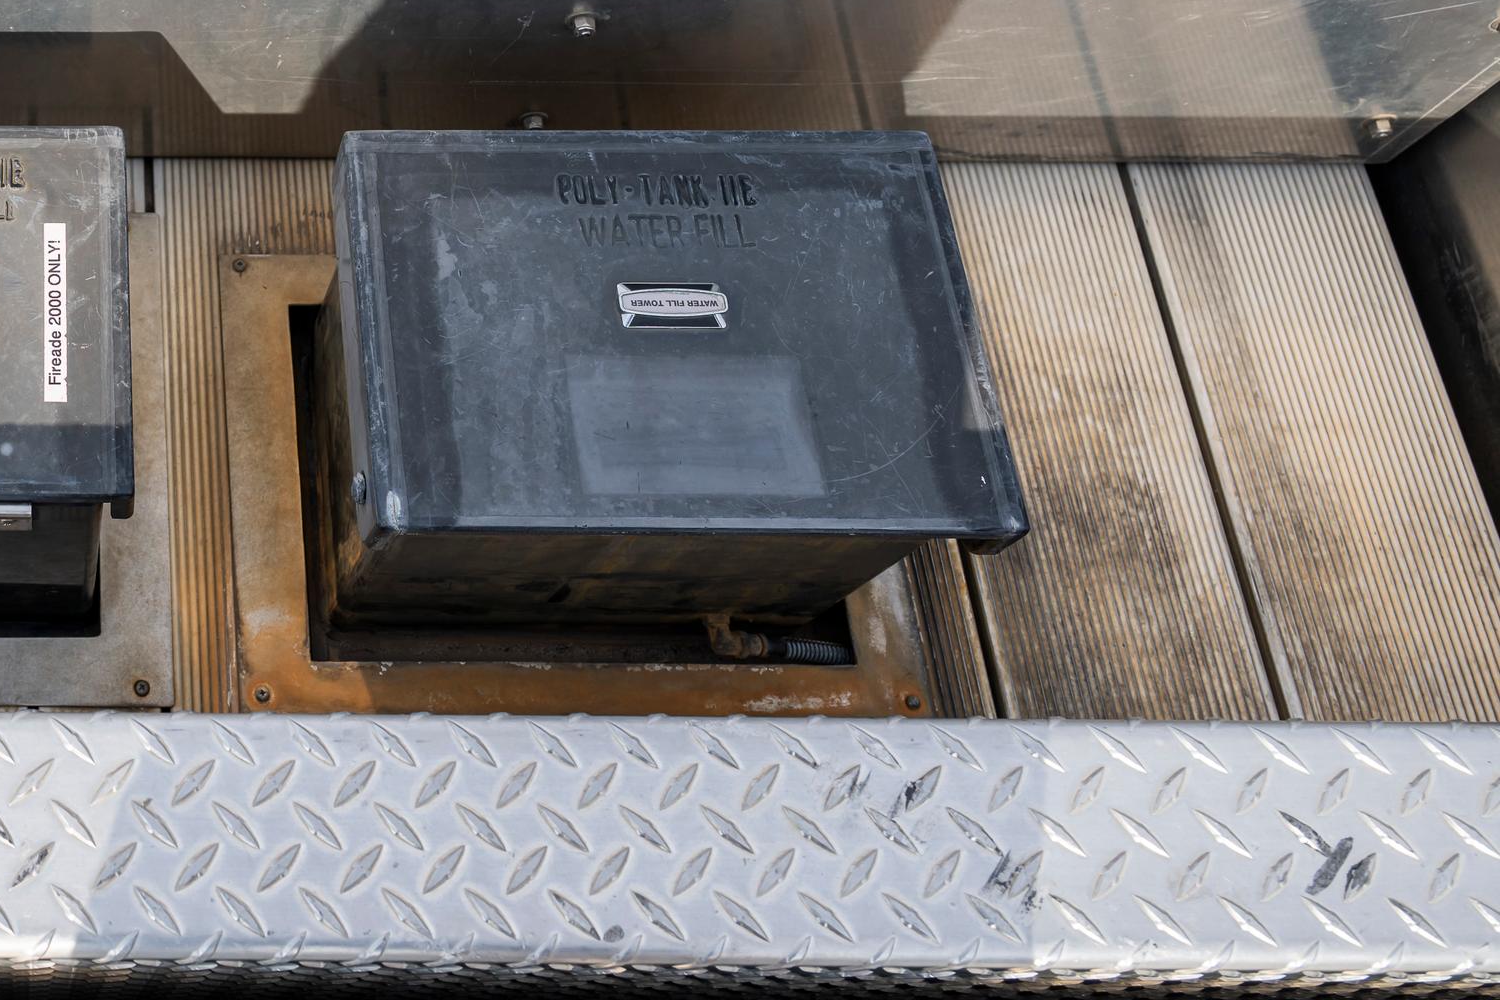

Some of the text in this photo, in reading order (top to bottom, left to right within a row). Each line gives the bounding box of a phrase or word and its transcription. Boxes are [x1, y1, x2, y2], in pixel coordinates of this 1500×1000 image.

[555, 172, 710, 209] POLY-TANK
[578, 213, 757, 249] WATER FILL
[47, 240, 62, 386] Fireade 2000 ONLY!
[630, 299, 719, 307] WATER FILL TOWER
